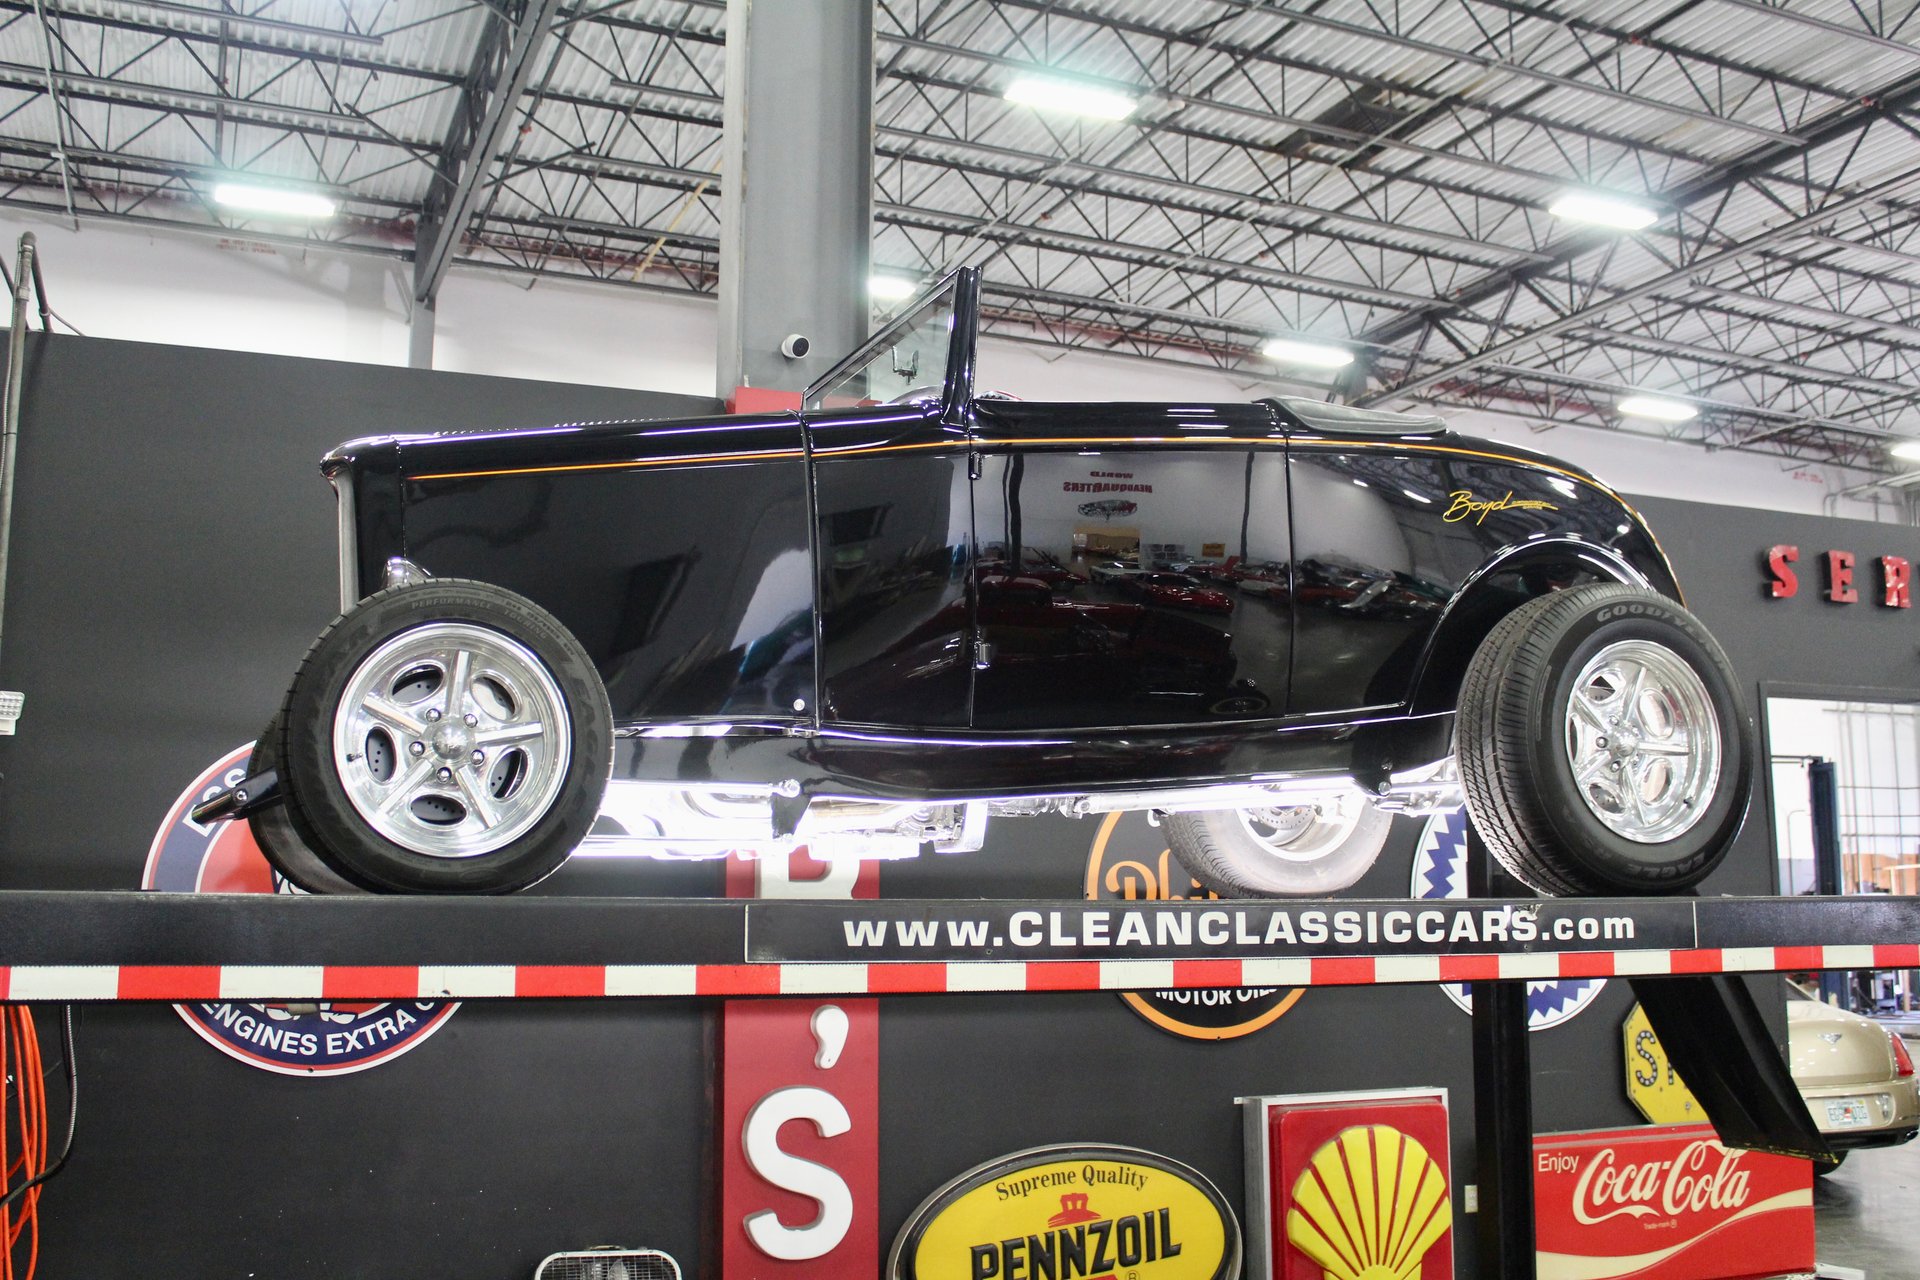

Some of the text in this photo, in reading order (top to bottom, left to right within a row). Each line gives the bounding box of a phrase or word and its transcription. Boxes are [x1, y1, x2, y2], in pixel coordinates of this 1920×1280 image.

[1442, 490, 1514, 526] Boyd
[843, 911, 1635, 947] www.CLEANCLASSICCARS.com
[326, 1008, 416, 1055] EXTRA
[1538, 1152, 1579, 1174] Enjoy
[996, 1165, 1149, 1201] Supreme Quality
[1572, 1139, 1751, 1225] Coca-Cola
[969, 1207, 1182, 1280] PENNZOIL
